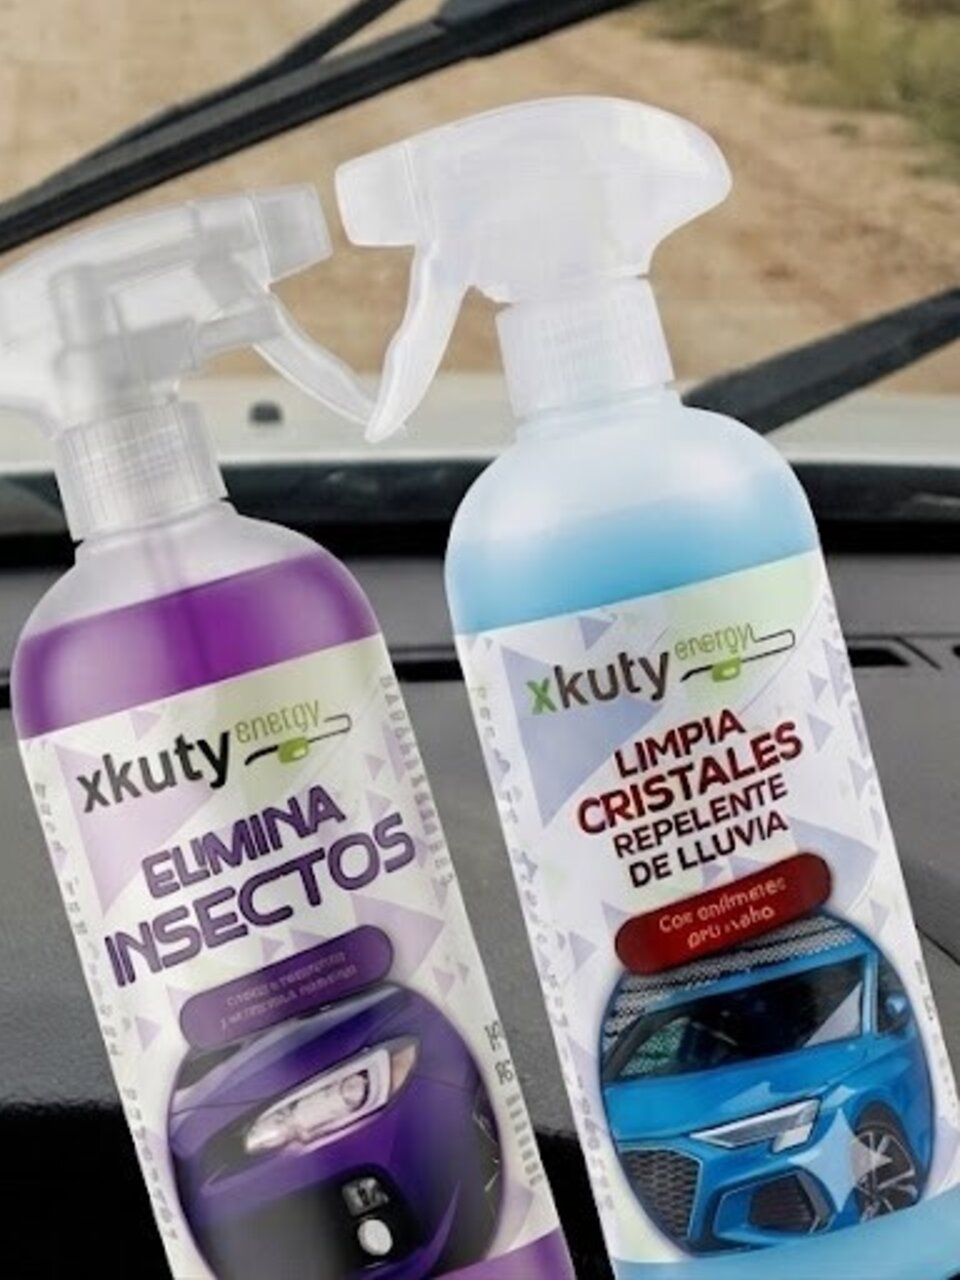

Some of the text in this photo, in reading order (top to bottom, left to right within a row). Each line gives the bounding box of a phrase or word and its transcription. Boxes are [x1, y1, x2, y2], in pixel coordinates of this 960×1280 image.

[526, 623, 754, 715] xkuty energy
[76, 730, 230, 813] xkuty
[234, 700, 320, 744] energy
[577, 721, 803, 835] CRISTALES
[614, 709, 746, 778] LIMPIA
[141, 784, 346, 899] ELIMINA
[613, 773, 788, 858] REPELENTE
[629, 811, 789, 888] DE LLUVIA
[104, 812, 415, 987] INSECTOS
